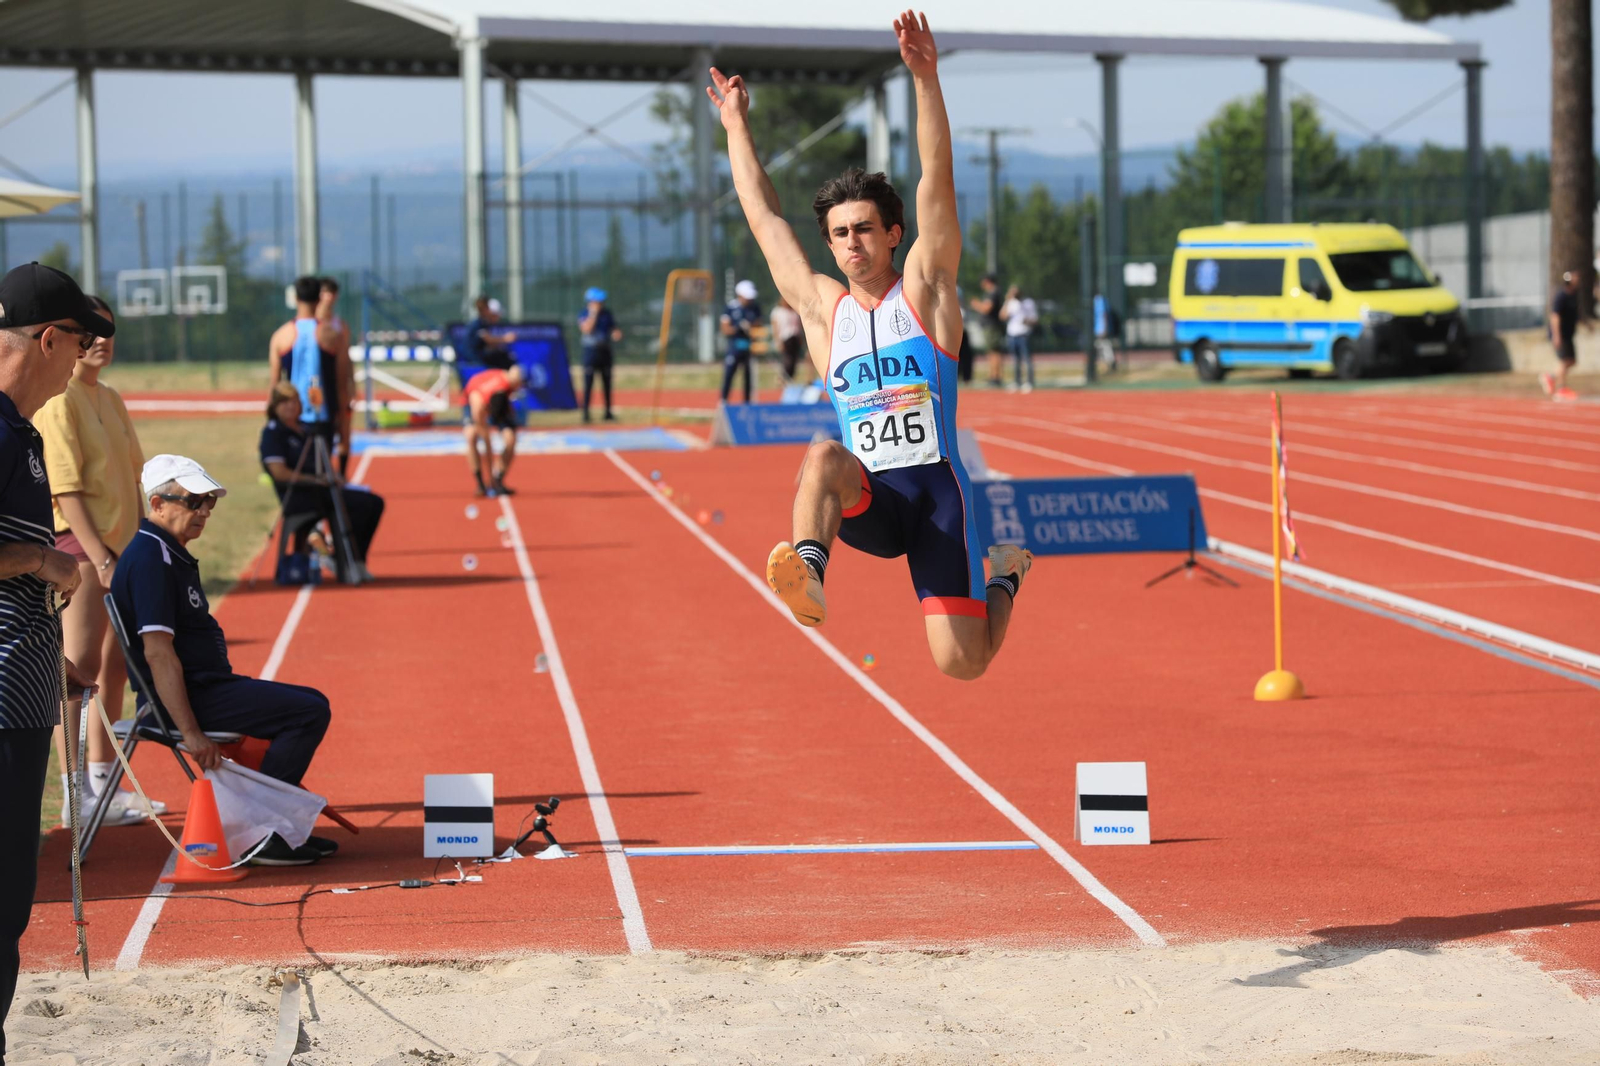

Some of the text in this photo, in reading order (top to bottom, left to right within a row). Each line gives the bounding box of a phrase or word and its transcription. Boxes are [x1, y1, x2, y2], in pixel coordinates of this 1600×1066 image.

[833, 351, 923, 392] SADA
[874, 395, 896, 405] GALICIA
[897, 391, 928, 400] ABSOLUTO
[858, 411, 925, 453] 346
[1028, 485, 1170, 516] DEPUTACIÓN
[1033, 518, 1140, 544] OURENSE
[437, 836, 479, 844] MONDO
[1094, 826, 1135, 834] MONDO
